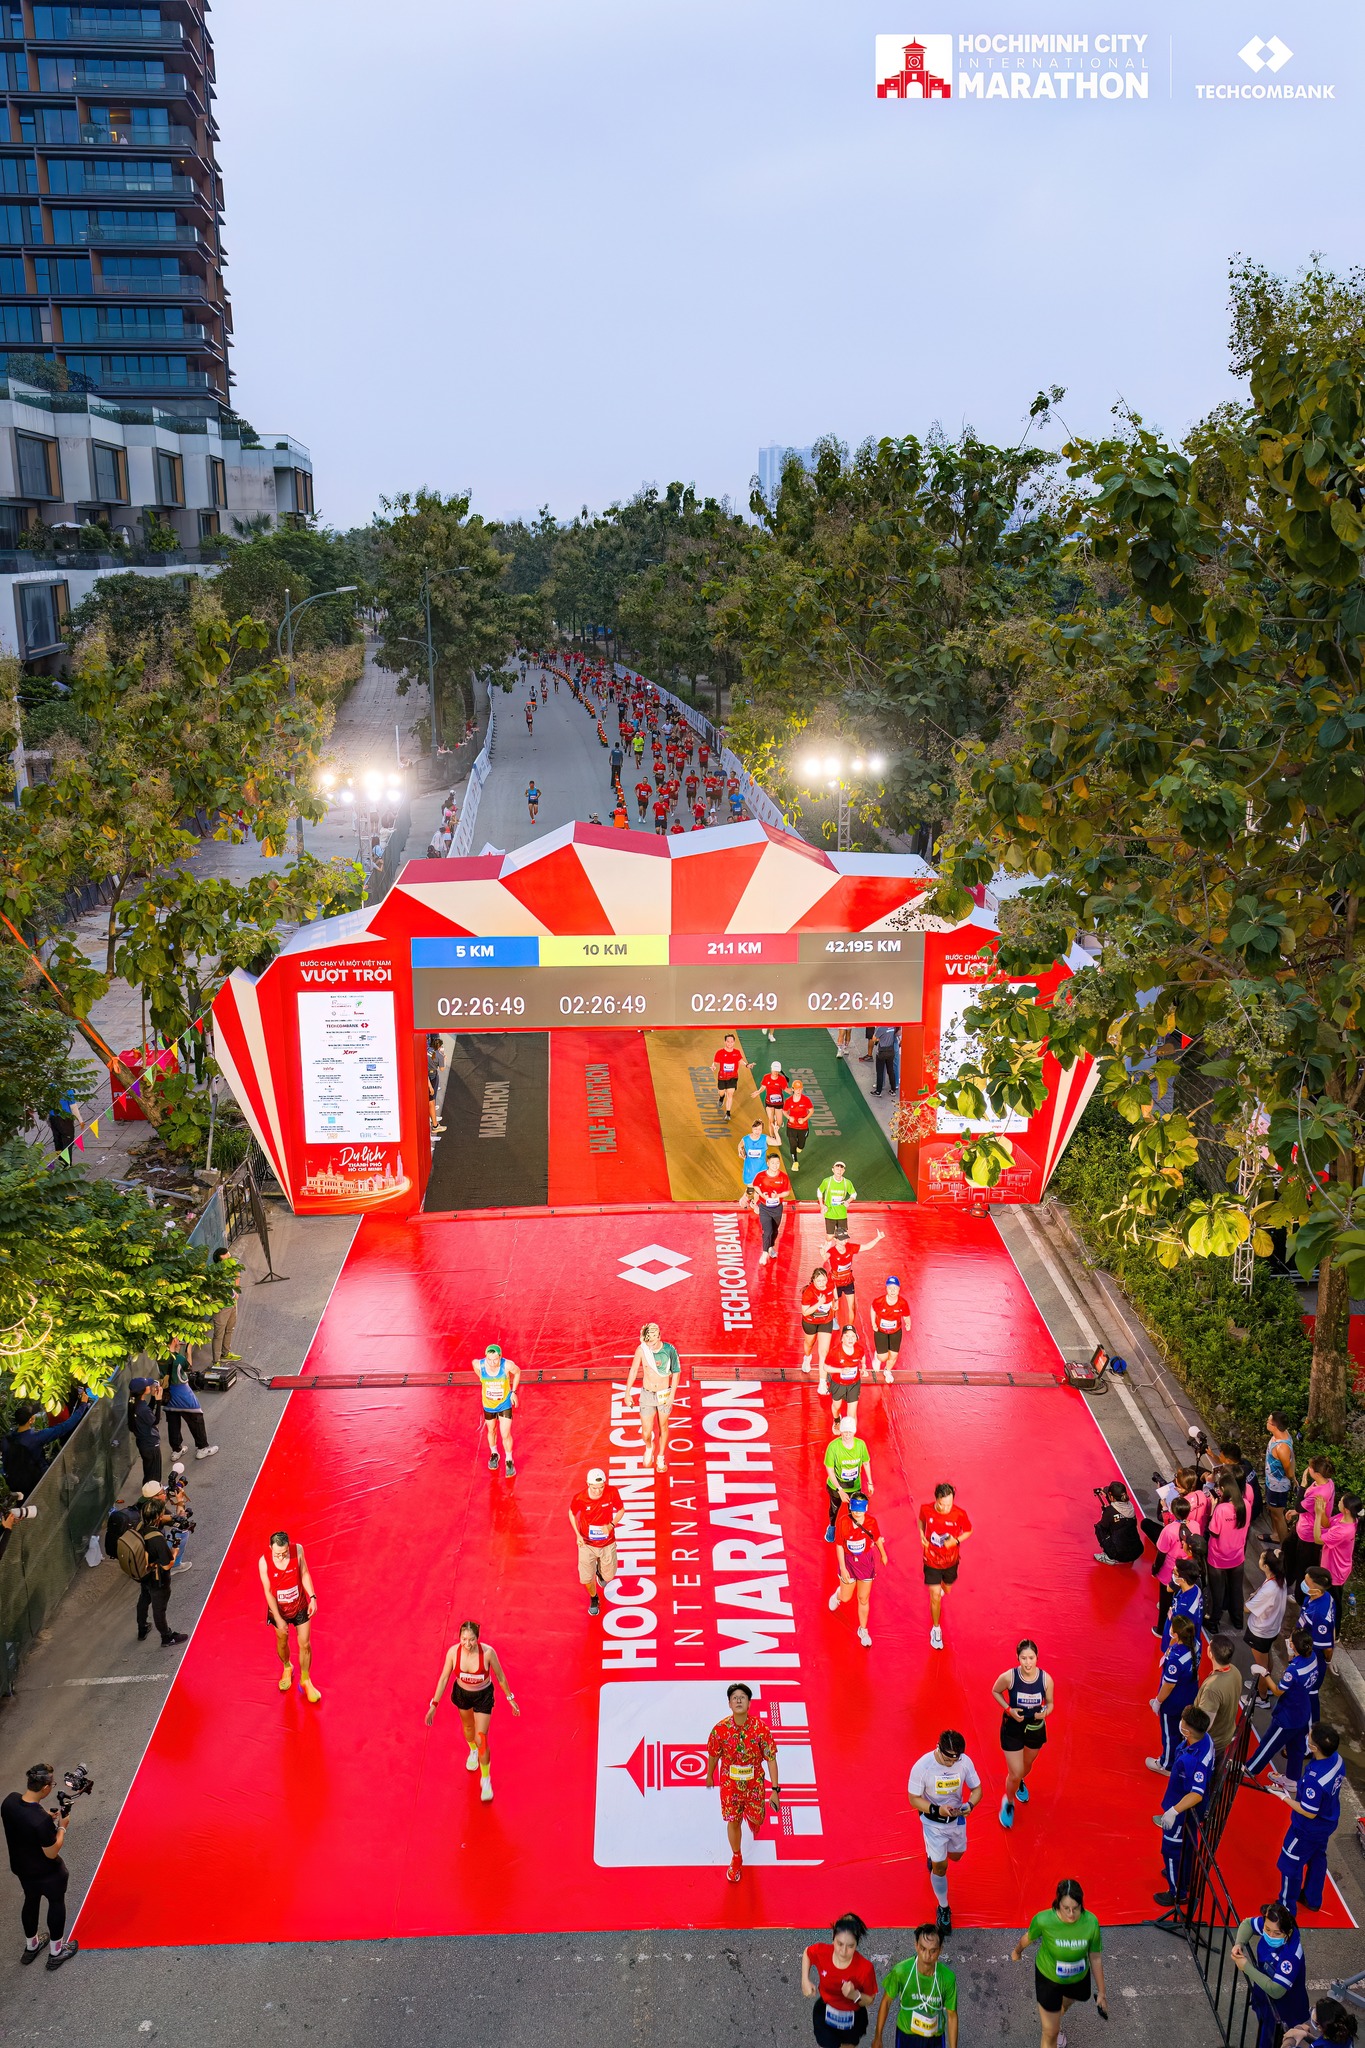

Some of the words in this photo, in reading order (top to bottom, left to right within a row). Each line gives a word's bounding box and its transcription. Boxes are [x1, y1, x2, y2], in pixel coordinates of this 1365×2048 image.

[456, 945, 466, 957] 5
[470, 945, 495, 957] KM
[583, 944, 599, 956] 10
[603, 943, 628, 955] KM
[707, 942, 733, 955] 21.1
[737, 941, 762, 954] KM
[825, 940, 873, 953] 42.195
[877, 939, 901, 952] KM
[300, 959, 319, 967] BƯỚC
[320, 960, 337, 968] CHẠY
[346, 960, 361, 968] MỘT
[300, 968, 349, 984] VƯỢT
[352, 967, 392, 984] TRỘI
[437, 996, 525, 1016] 02:26:49
[559, 995, 647, 1014] 02:26:49
[691, 993, 778, 1012] 02:26:49
[807, 991, 894, 1011] 02:26:49
[585, 1063, 614, 1117] MARATHON
[688, 1066, 728, 1125] KILOMETERS
[479, 1081, 510, 1138] MARATHON
[588, 1125, 617, 1153] HALF
[703, 1127, 732, 1139] 10
[339, 1146, 360, 1166] Du
[712, 1212, 753, 1332] TECHCOMBANK
[609, 1382, 655, 1448] CITY
[668, 1380, 705, 1667] INTERNATIONAL
[700, 1380, 801, 1668] MARATHON
[602, 1455, 657, 1669] HOCHIMINH
